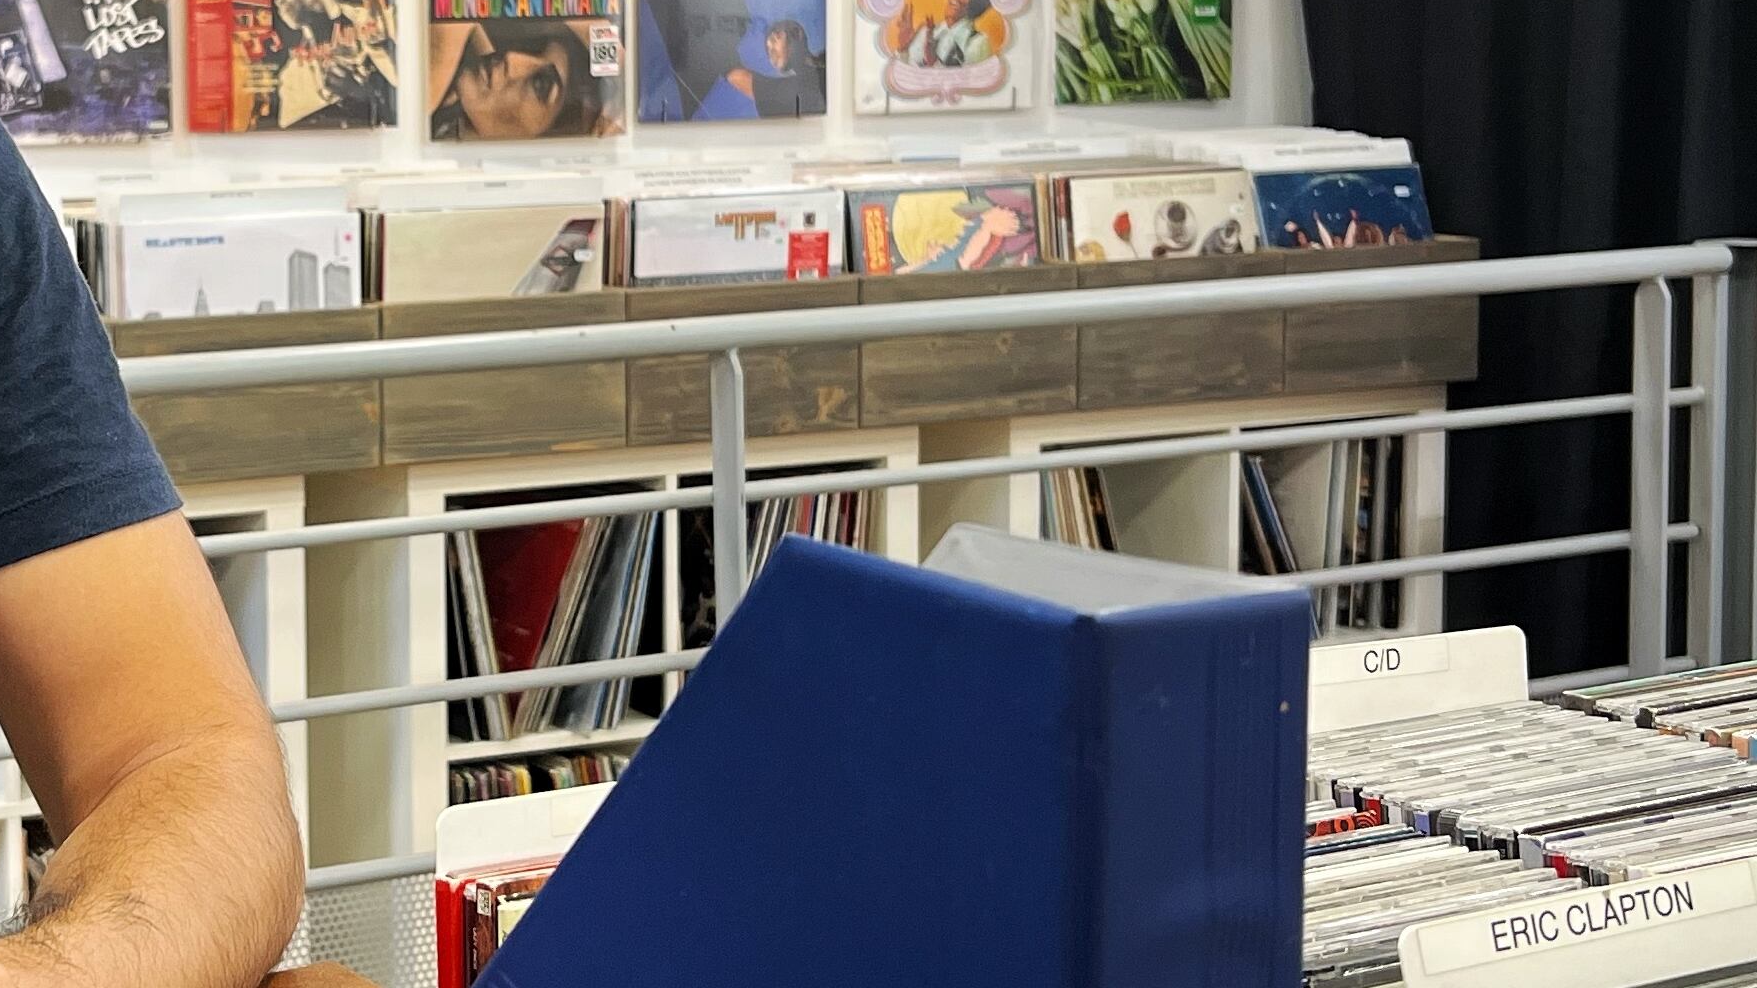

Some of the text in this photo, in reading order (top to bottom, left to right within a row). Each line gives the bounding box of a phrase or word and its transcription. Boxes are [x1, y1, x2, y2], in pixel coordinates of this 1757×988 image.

[1363, 647, 1401, 674] C/D
[1490, 880, 1695, 953] ERIC CLAPTON
